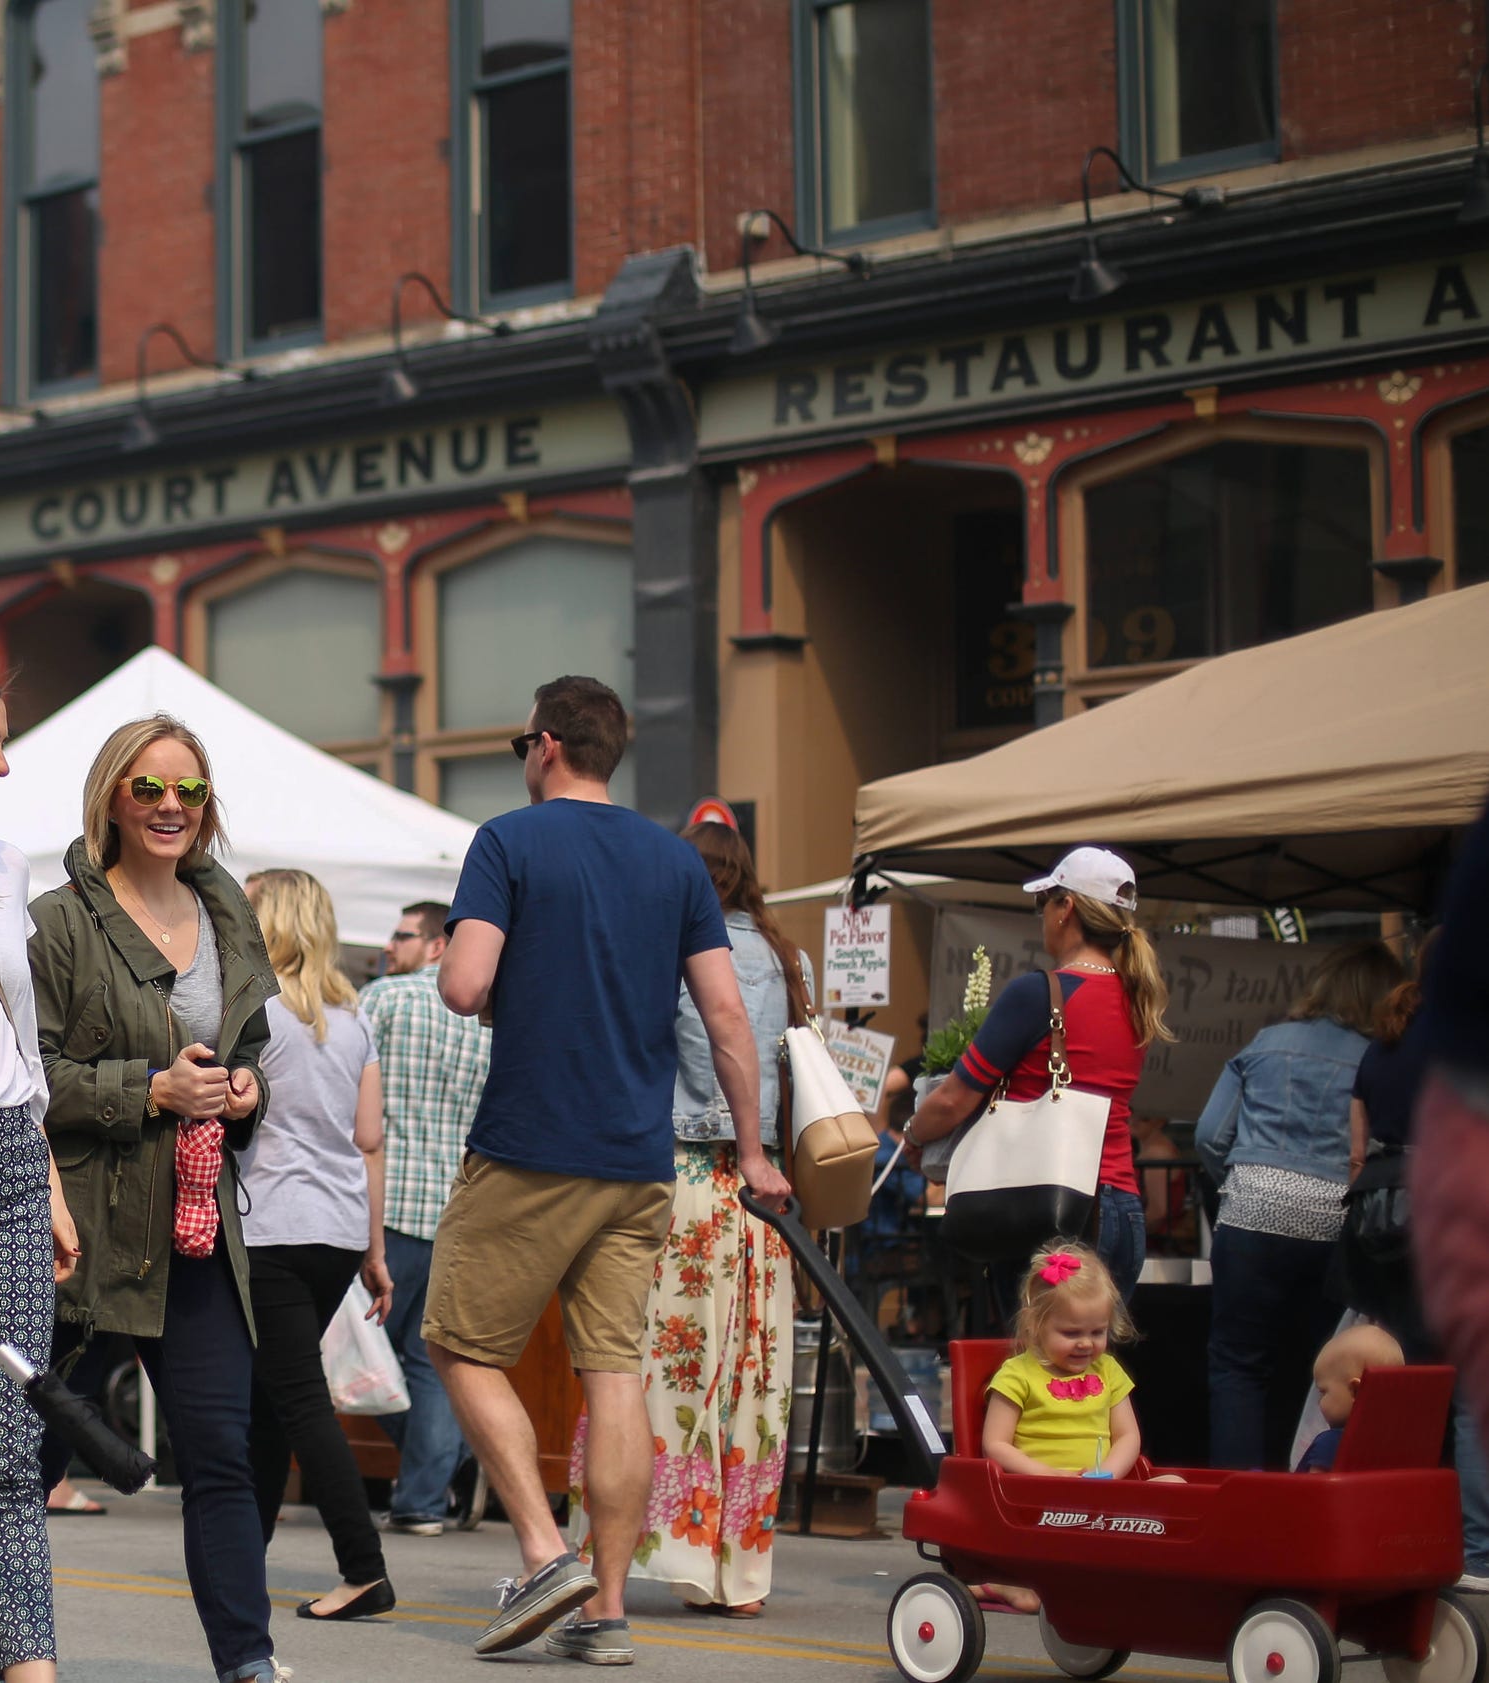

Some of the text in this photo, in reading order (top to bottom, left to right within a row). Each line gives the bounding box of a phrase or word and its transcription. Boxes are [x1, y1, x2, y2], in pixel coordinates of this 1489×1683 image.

[773, 277, 1377, 427] RESTAURANT
[28, 417, 543, 542] COURT AVENUE
[987, 604, 1177, 681] 39
[829, 927, 886, 946] Pie Flavor
[842, 910, 872, 930] NEW
[1038, 1511, 1165, 1535] RADIO FLYER
